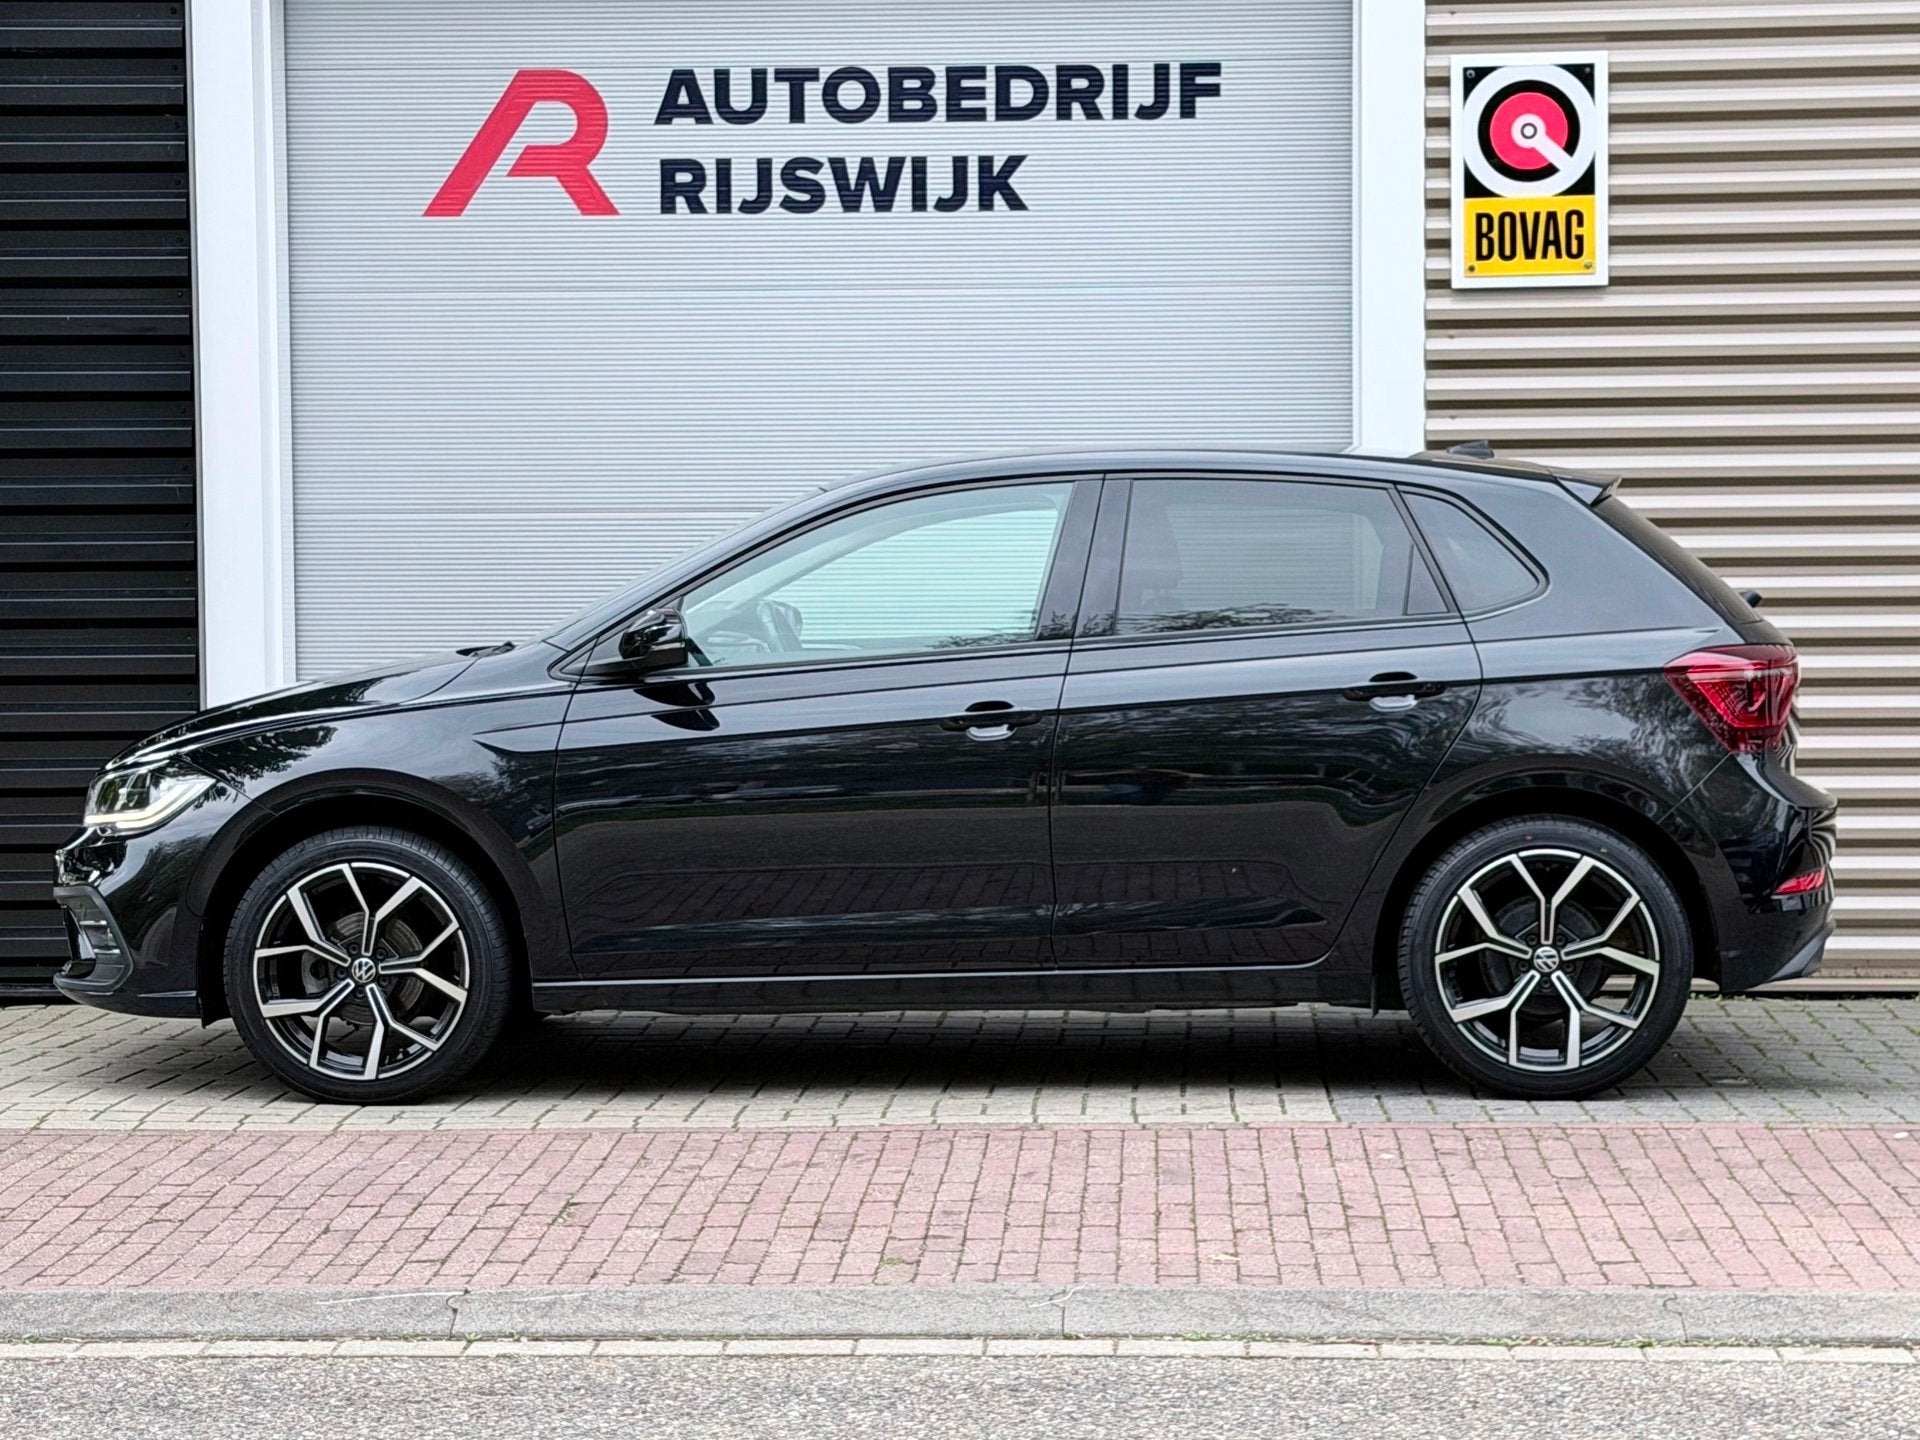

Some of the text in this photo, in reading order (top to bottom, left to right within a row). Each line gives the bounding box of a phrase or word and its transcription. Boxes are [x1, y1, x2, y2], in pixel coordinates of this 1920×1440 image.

[655, 62, 1221, 125] AUTOBEDRIJF
[661, 155, 1027, 214] RIJSWIJK
[1476, 209, 1585, 262] BOVAG
